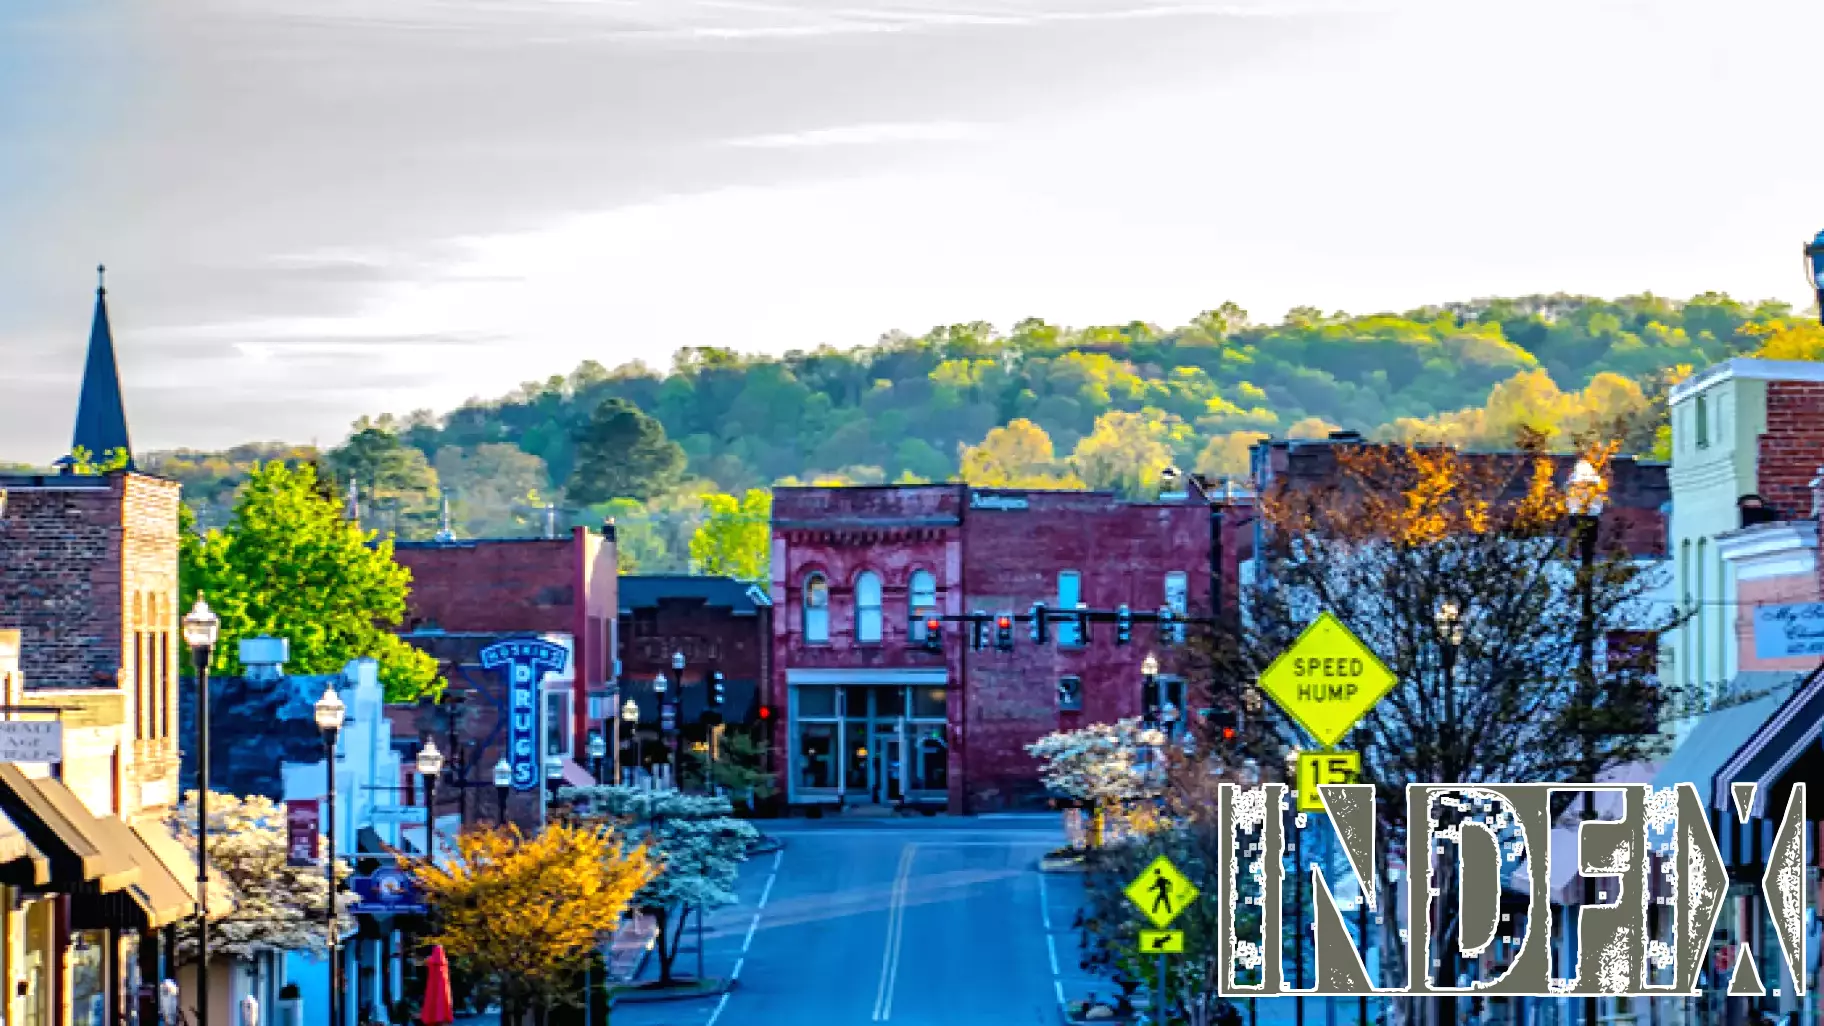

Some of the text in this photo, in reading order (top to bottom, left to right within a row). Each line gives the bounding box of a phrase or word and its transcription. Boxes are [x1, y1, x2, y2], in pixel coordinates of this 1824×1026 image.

[1293, 658, 1364, 677] SPEED
[1297, 684, 1359, 703] HUMP
[515, 665, 531, 783] DRUGS
[1310, 759, 1354, 786] 15
